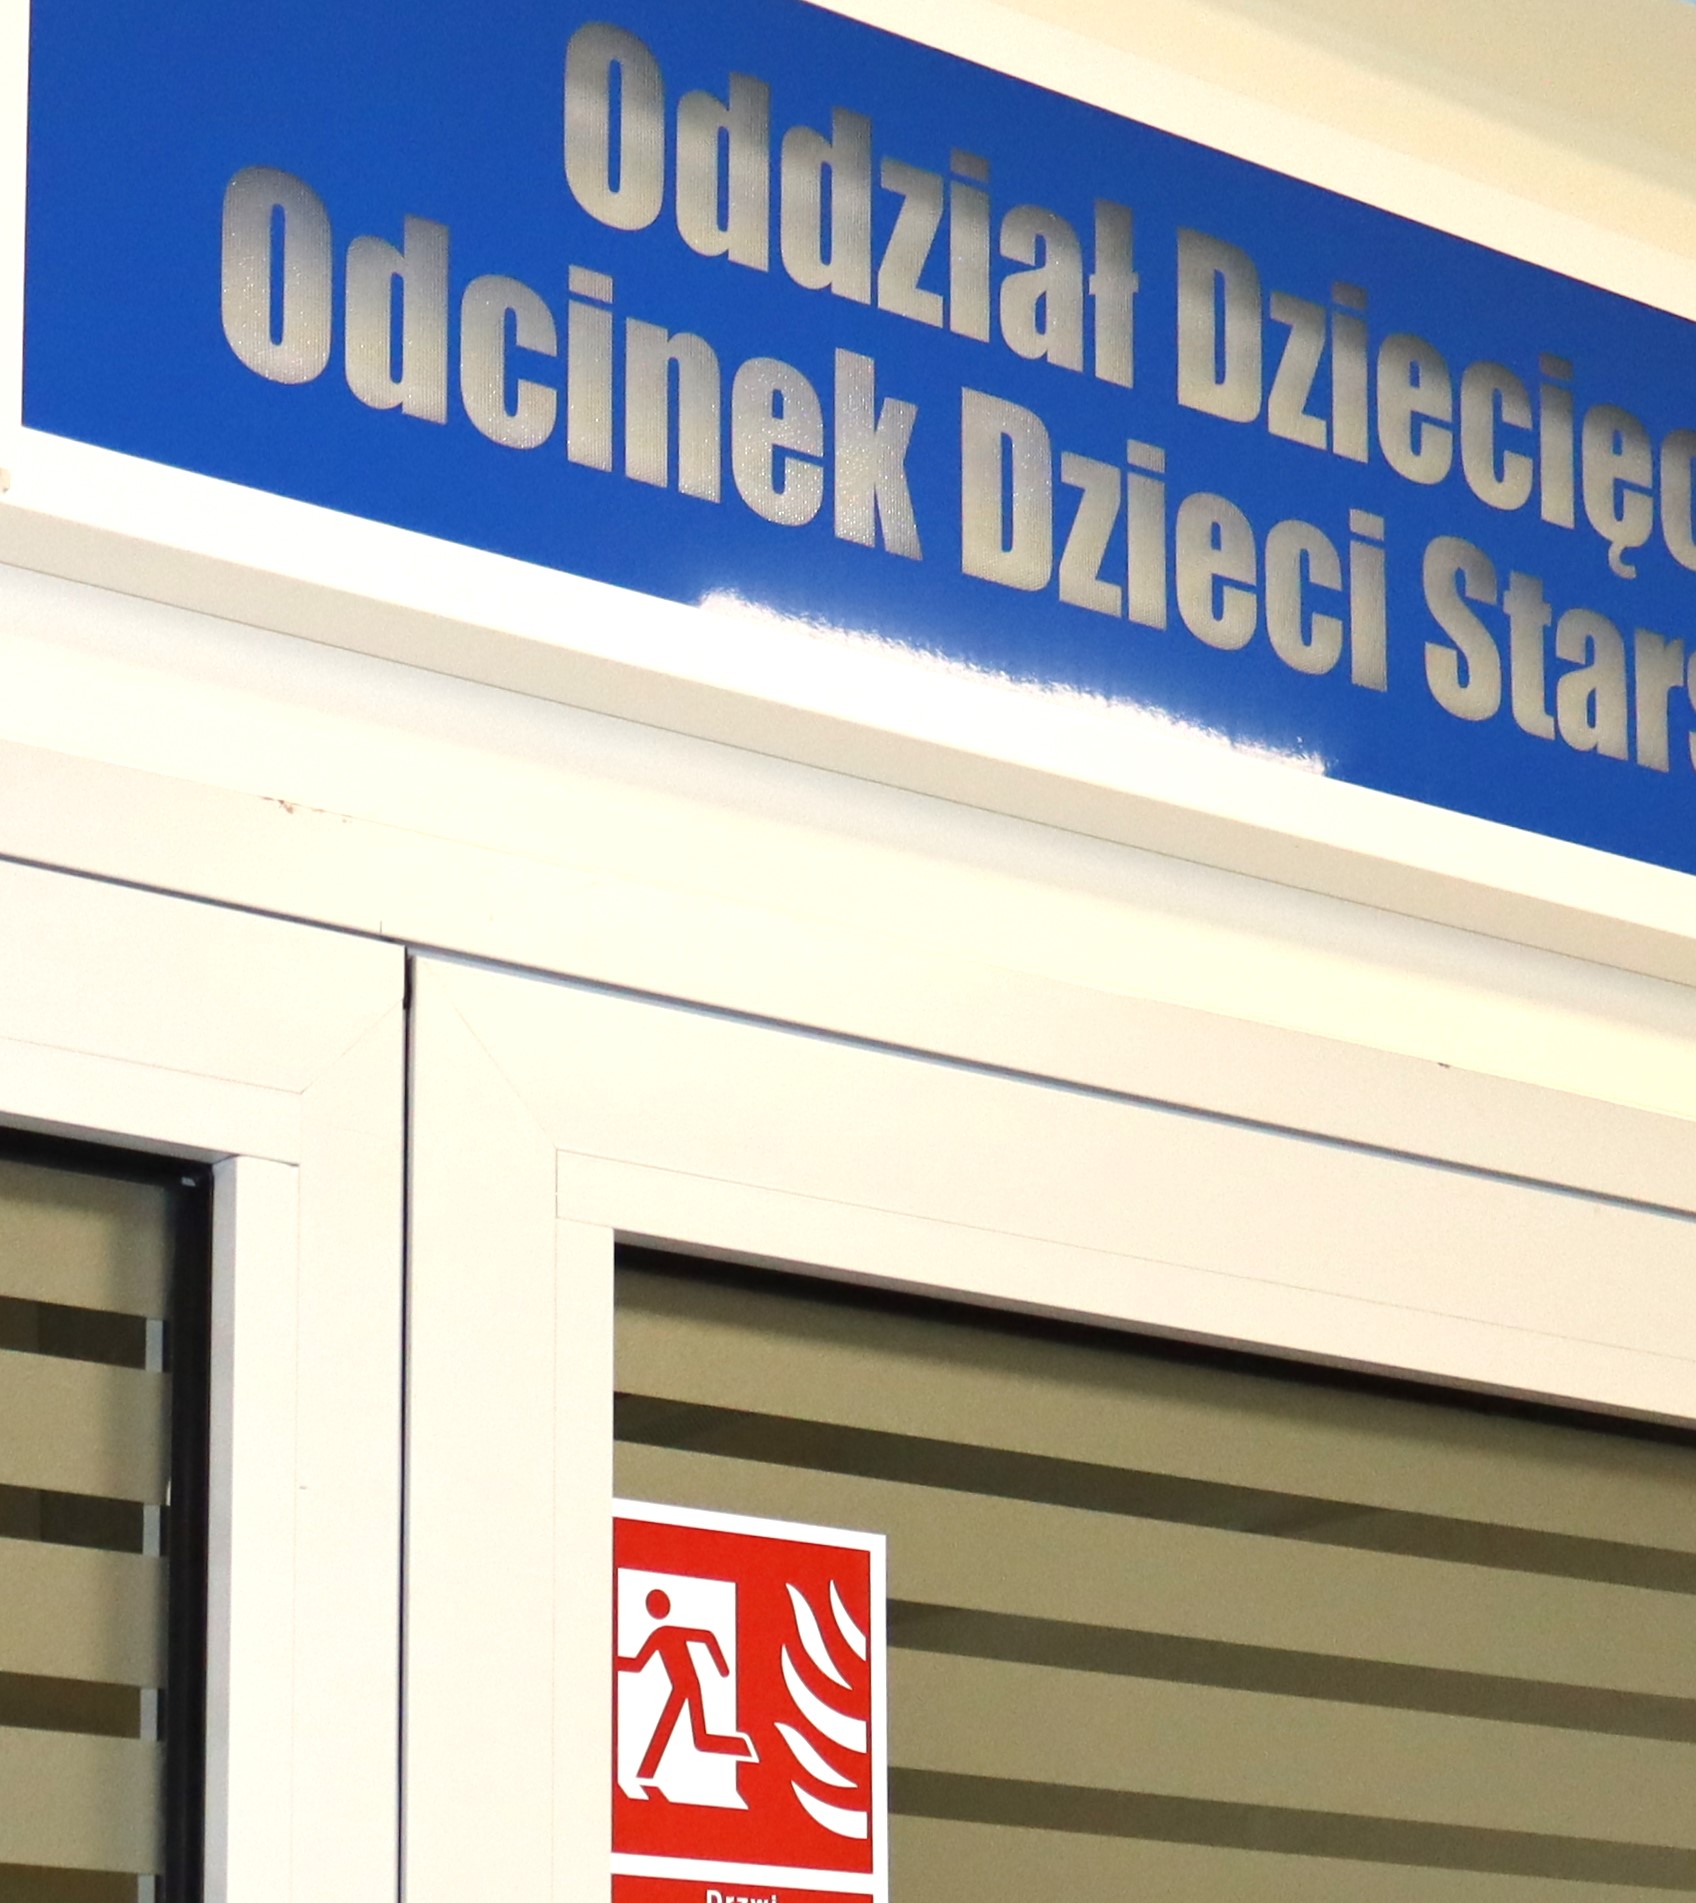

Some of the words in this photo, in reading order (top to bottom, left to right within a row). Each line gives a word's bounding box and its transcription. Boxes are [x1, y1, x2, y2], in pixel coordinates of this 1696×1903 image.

[563, 21, 1139, 388] Oddział
[221, 165, 922, 560] Odcinek
[962, 386, 1387, 691] Dzieci
